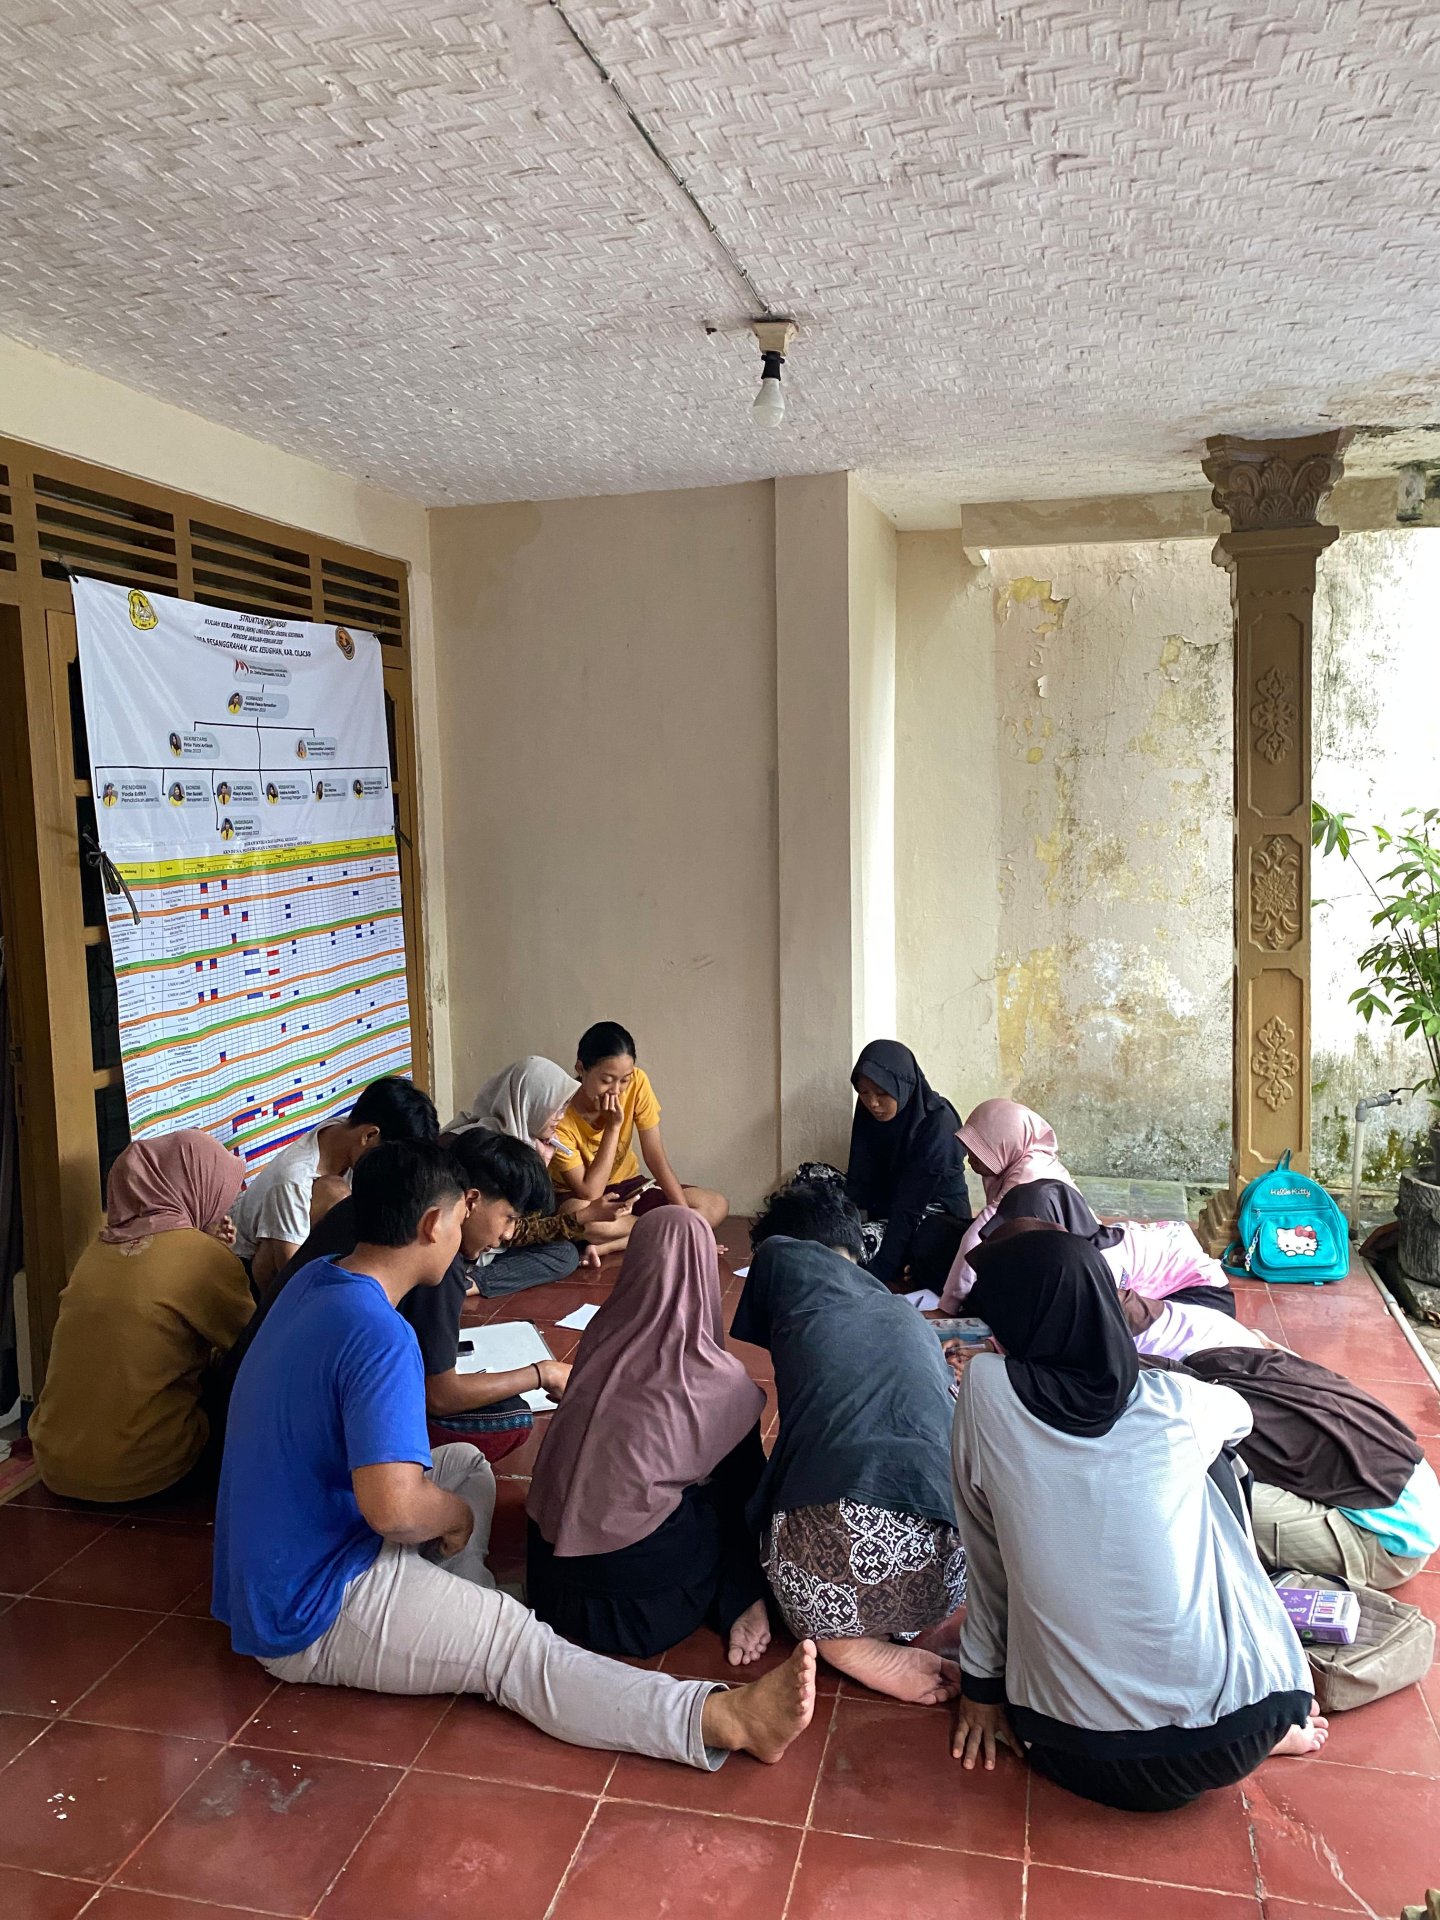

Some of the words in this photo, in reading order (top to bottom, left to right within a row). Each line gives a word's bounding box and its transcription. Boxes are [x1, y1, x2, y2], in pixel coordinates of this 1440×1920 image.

[239, 615, 264, 625] STRUKTUR
[1270, 1188, 1291, 1196] Hello
[1291, 1188, 1311, 1198] Kitty
